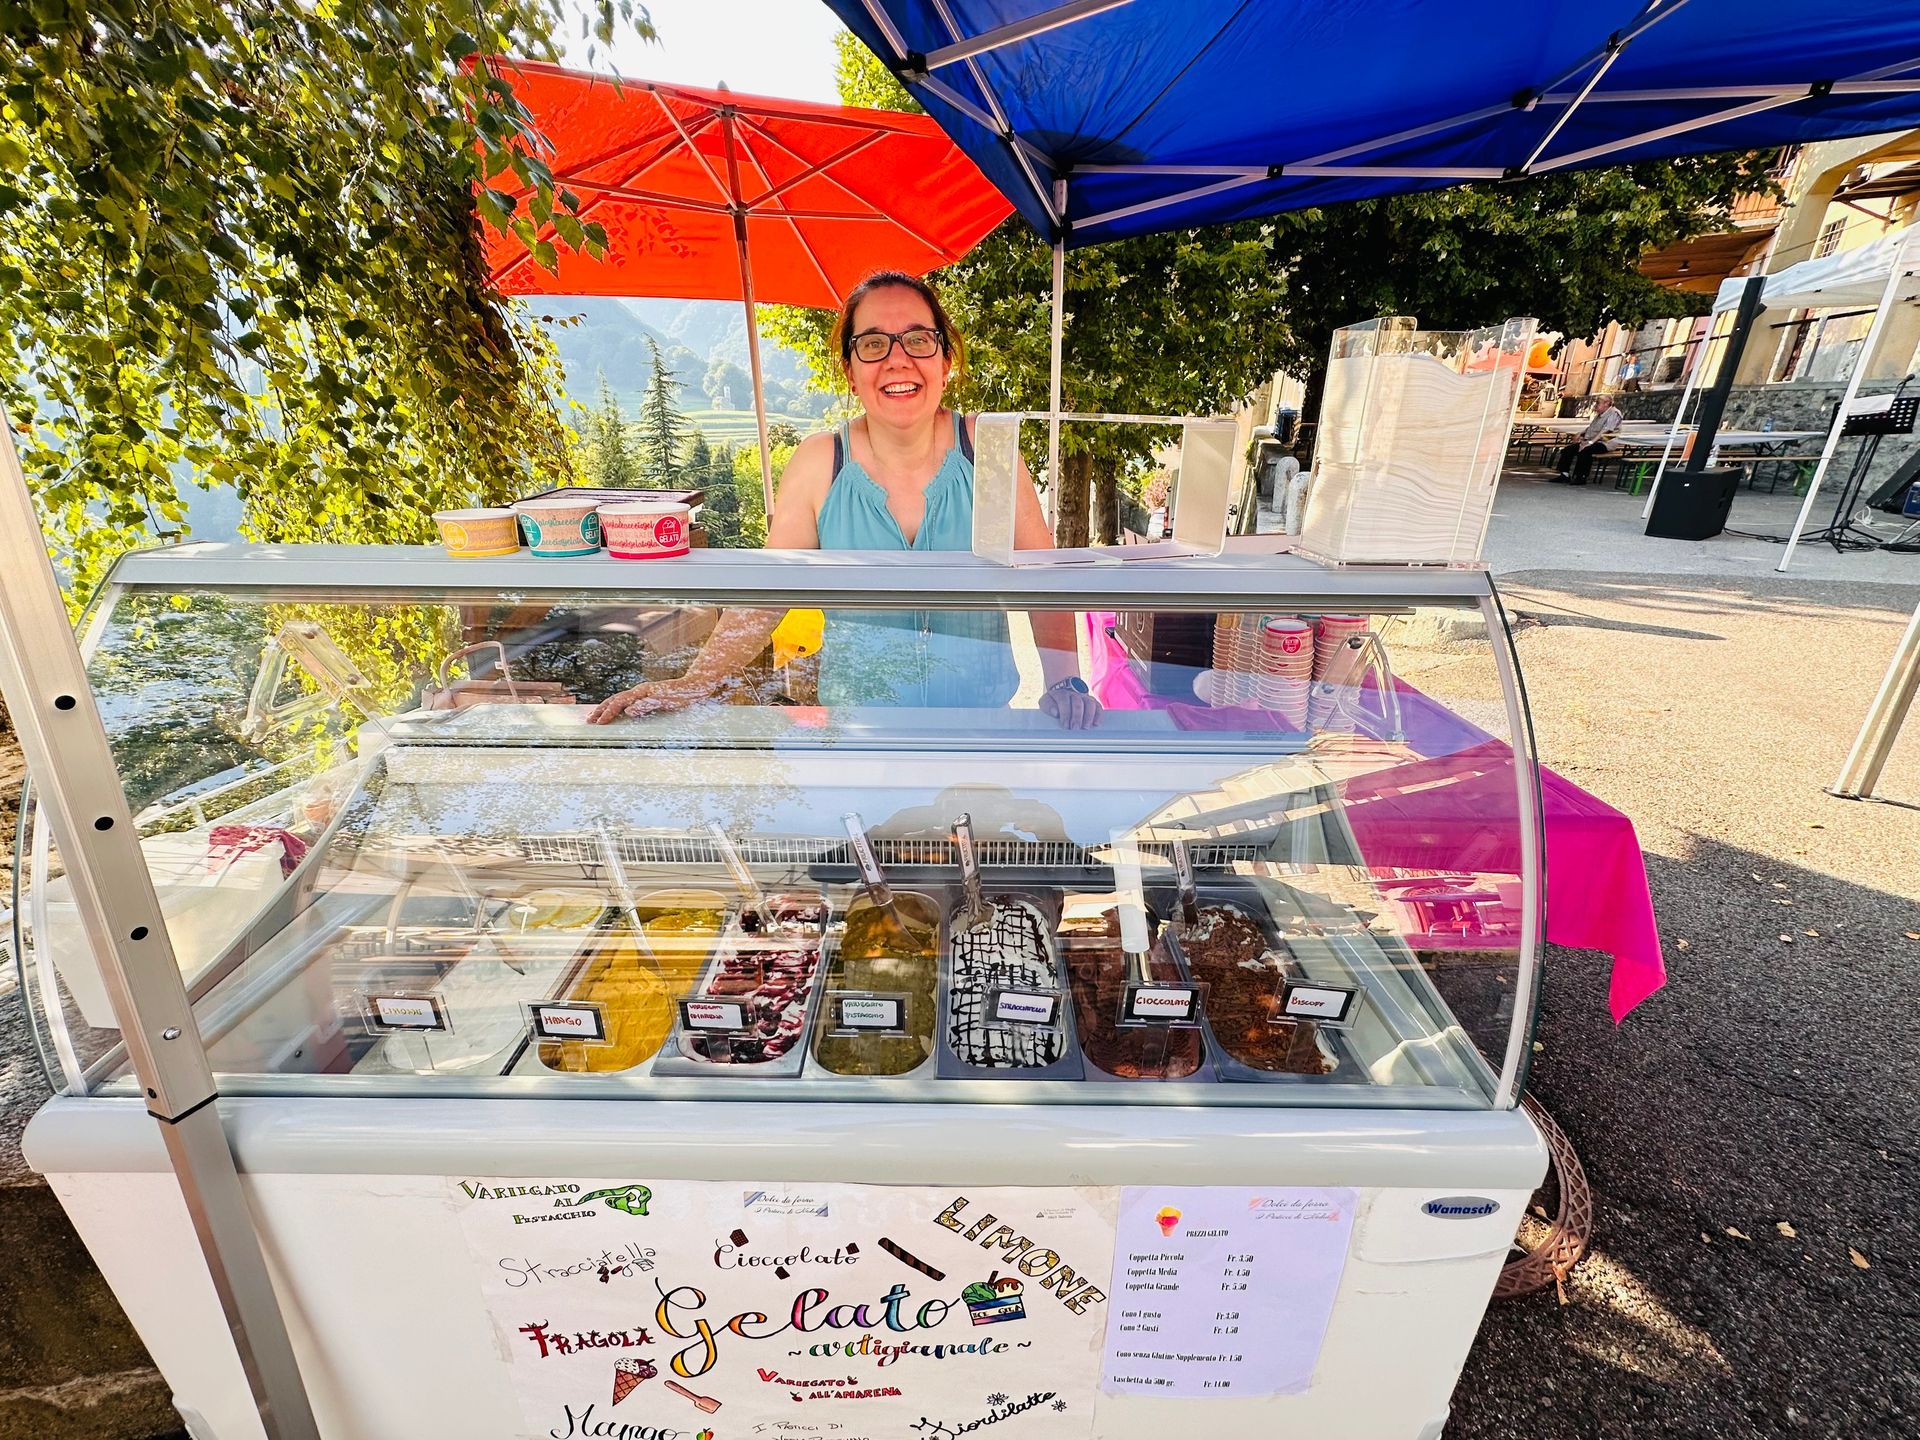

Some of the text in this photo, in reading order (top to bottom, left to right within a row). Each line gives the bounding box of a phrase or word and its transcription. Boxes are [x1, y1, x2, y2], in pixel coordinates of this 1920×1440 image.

[1135, 996, 1192, 1007] CIOCCOLATO
[553, 1198, 577, 1207] AL
[713, 1238, 860, 1270] Cioccolato
[933, 1196, 1107, 1316] LIMONE
[1129, 1253, 1159, 1262] Coppetta
[1127, 1268, 1156, 1277] Coppetta
[1125, 1282, 1154, 1291] Coppetta
[654, 1278, 961, 1378] Gelato
[518, 1319, 656, 1358] FRAGOLA
[808, 1333, 1010, 1368] artigianale
[756, 1368, 846, 1388] VARIEGATO
